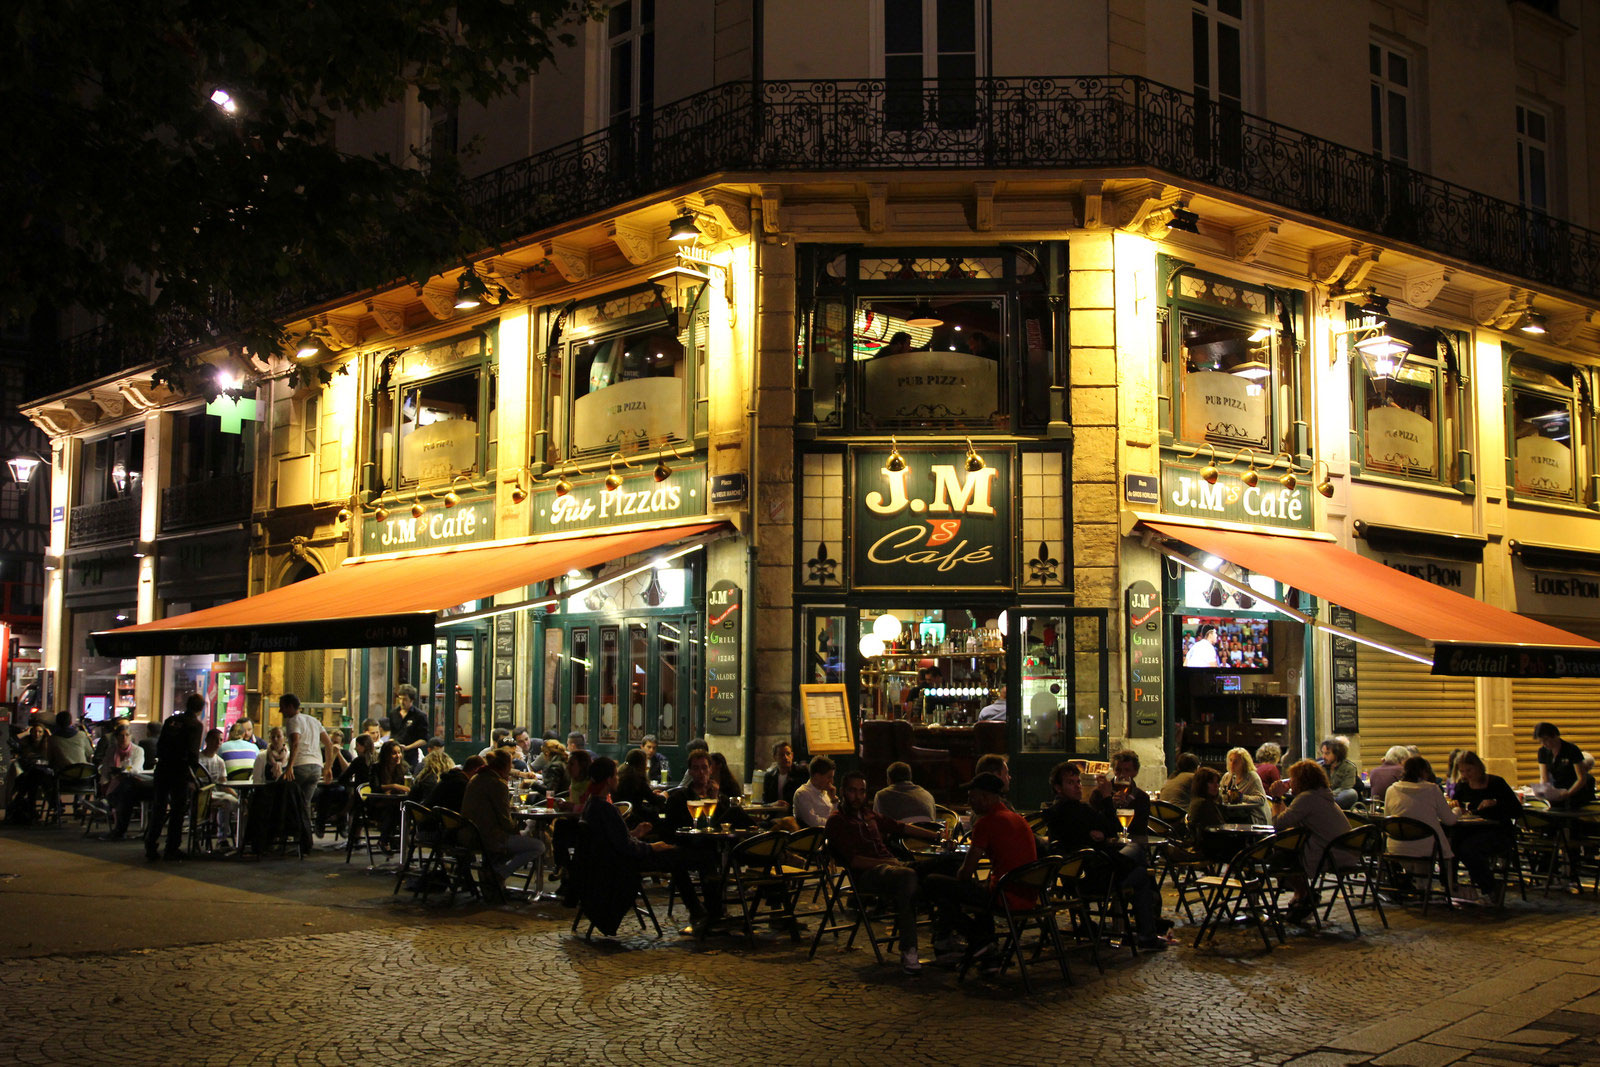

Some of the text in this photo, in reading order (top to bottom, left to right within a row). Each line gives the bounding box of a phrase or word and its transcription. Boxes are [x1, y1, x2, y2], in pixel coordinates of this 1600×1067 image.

[898, 375, 965, 386] PUB PIZZA
[624, 401, 647, 411] PIZZA
[1205, 395, 1247, 412] PUB PIZZA
[1399, 430, 1418, 443] PIZZA
[550, 494, 596, 525] Pub
[1243, 486, 1302, 521] Café
[430, 506, 476, 540] Café
[867, 524, 994, 572] Café
[1428, 563, 1461, 587] PION
[1534, 575, 1599, 599] LOUIS PION
[1450, 650, 1508, 673] Cocktail
[1519, 653, 1546, 674] Pub
